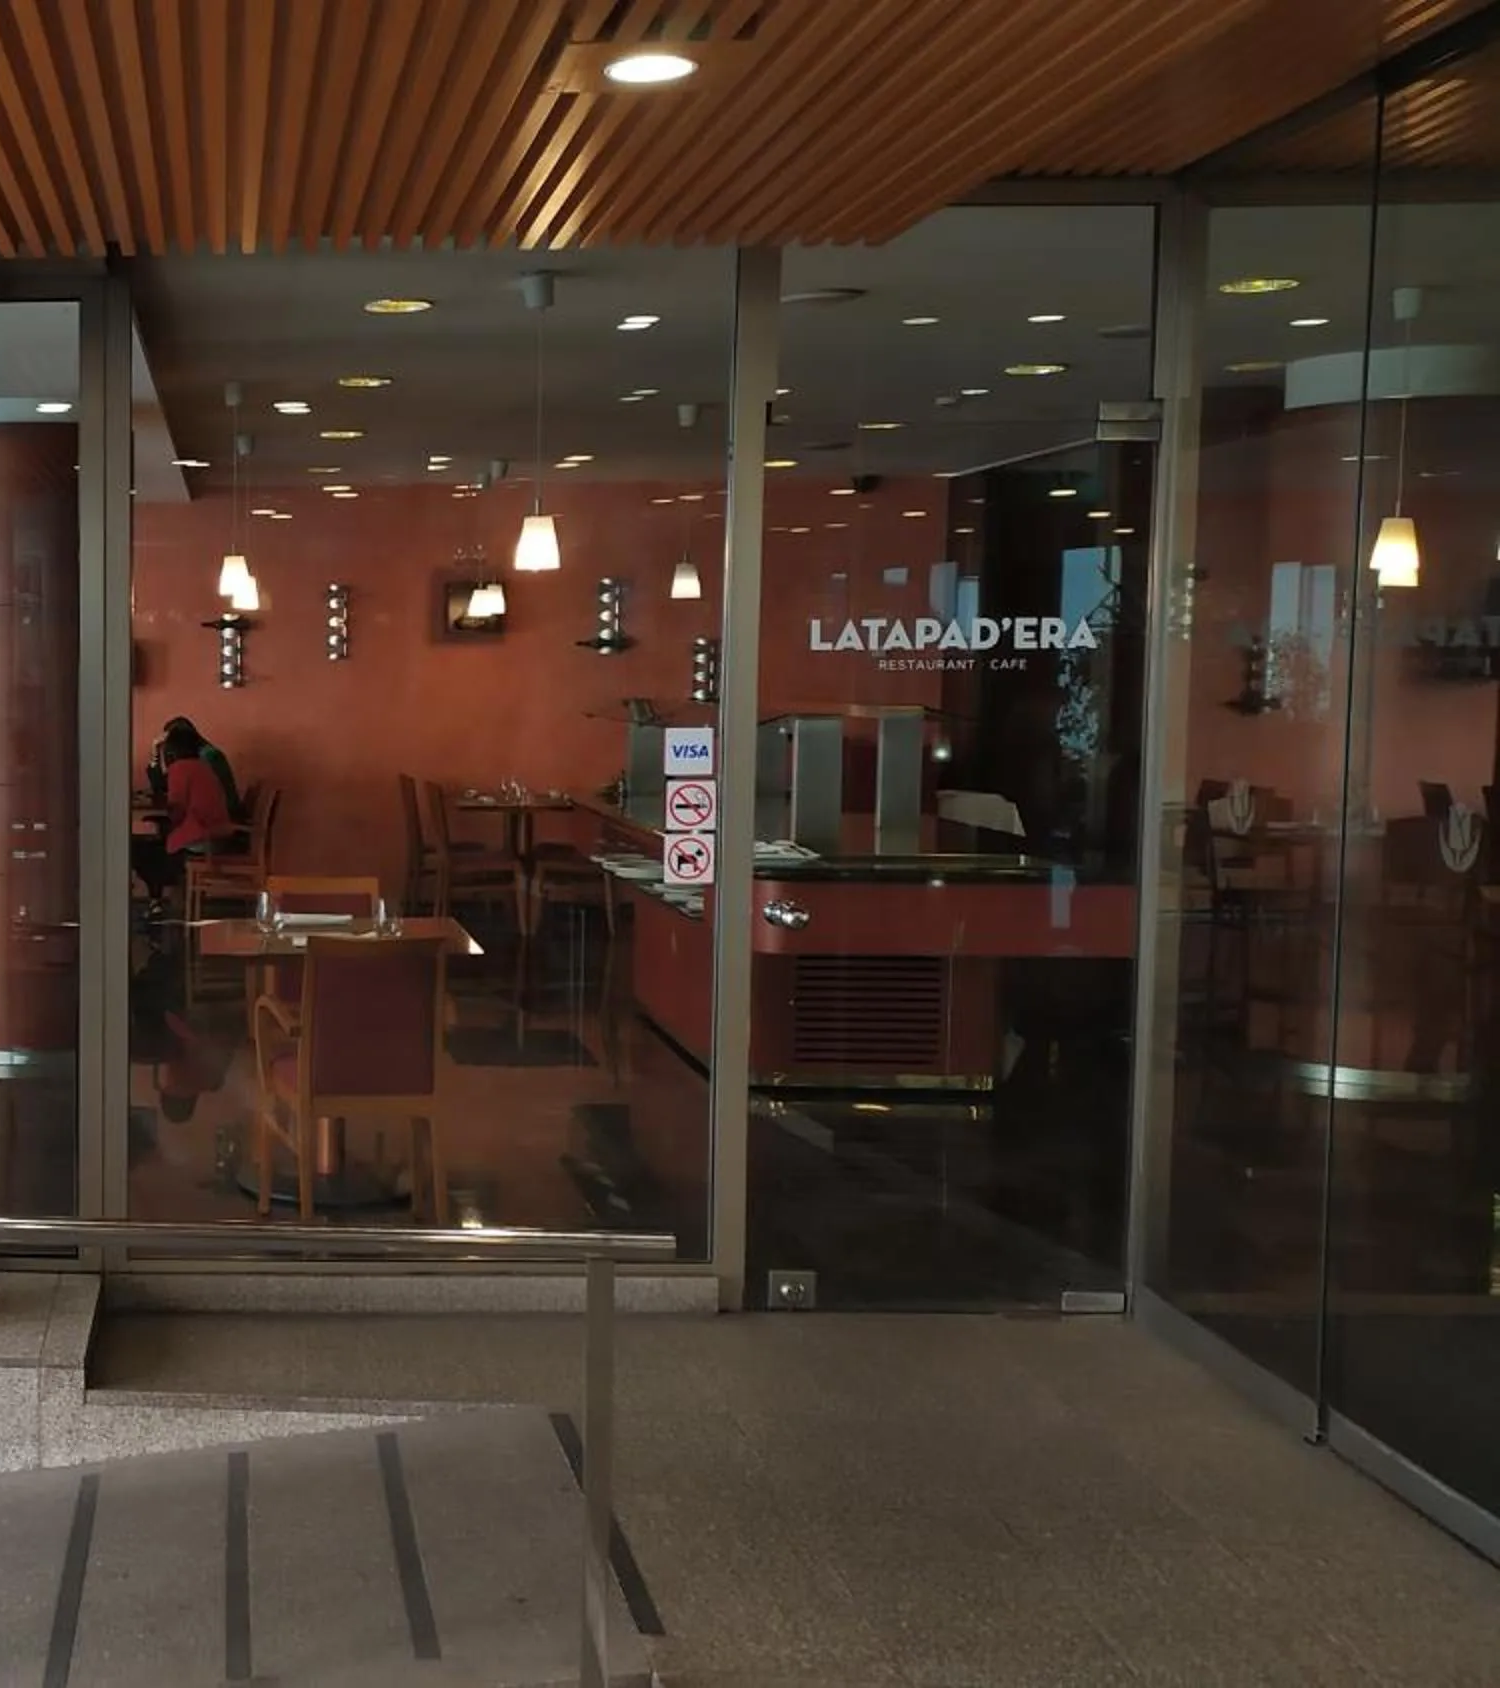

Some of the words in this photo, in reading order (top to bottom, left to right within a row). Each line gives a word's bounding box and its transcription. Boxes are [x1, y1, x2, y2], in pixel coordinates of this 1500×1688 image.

[810, 617, 1098, 651] LATAPAD'ERA
[879, 658, 976, 671] RESTAURANT
[990, 658, 1028, 671] CAFE
[672, 744, 710, 759] VISA
